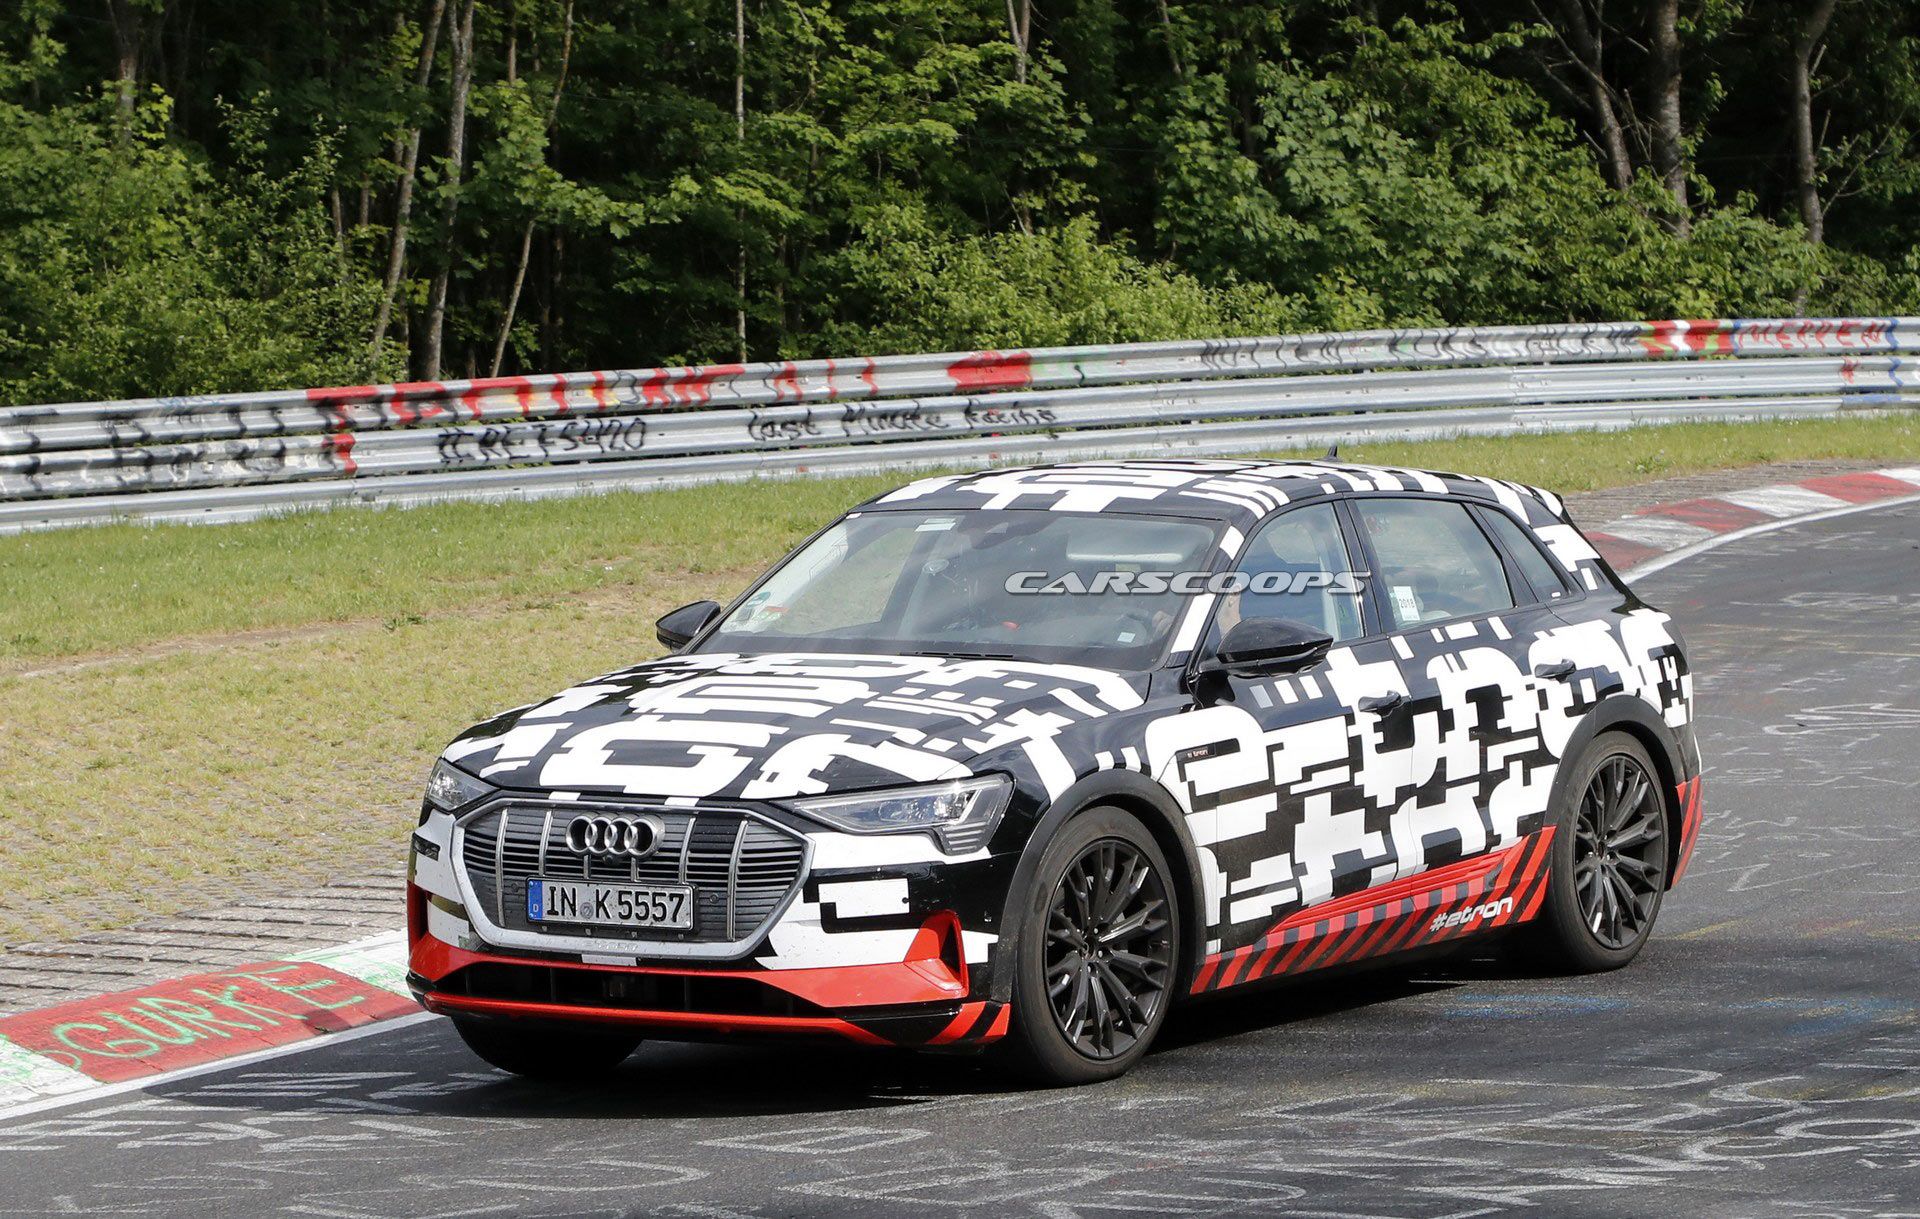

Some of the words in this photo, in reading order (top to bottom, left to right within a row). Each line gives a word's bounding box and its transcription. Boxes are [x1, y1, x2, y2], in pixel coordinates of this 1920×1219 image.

[547, 886, 577, 916] IN
[1429, 896, 1513, 932] #etron
[53, 965, 364, 1059] GURKE
